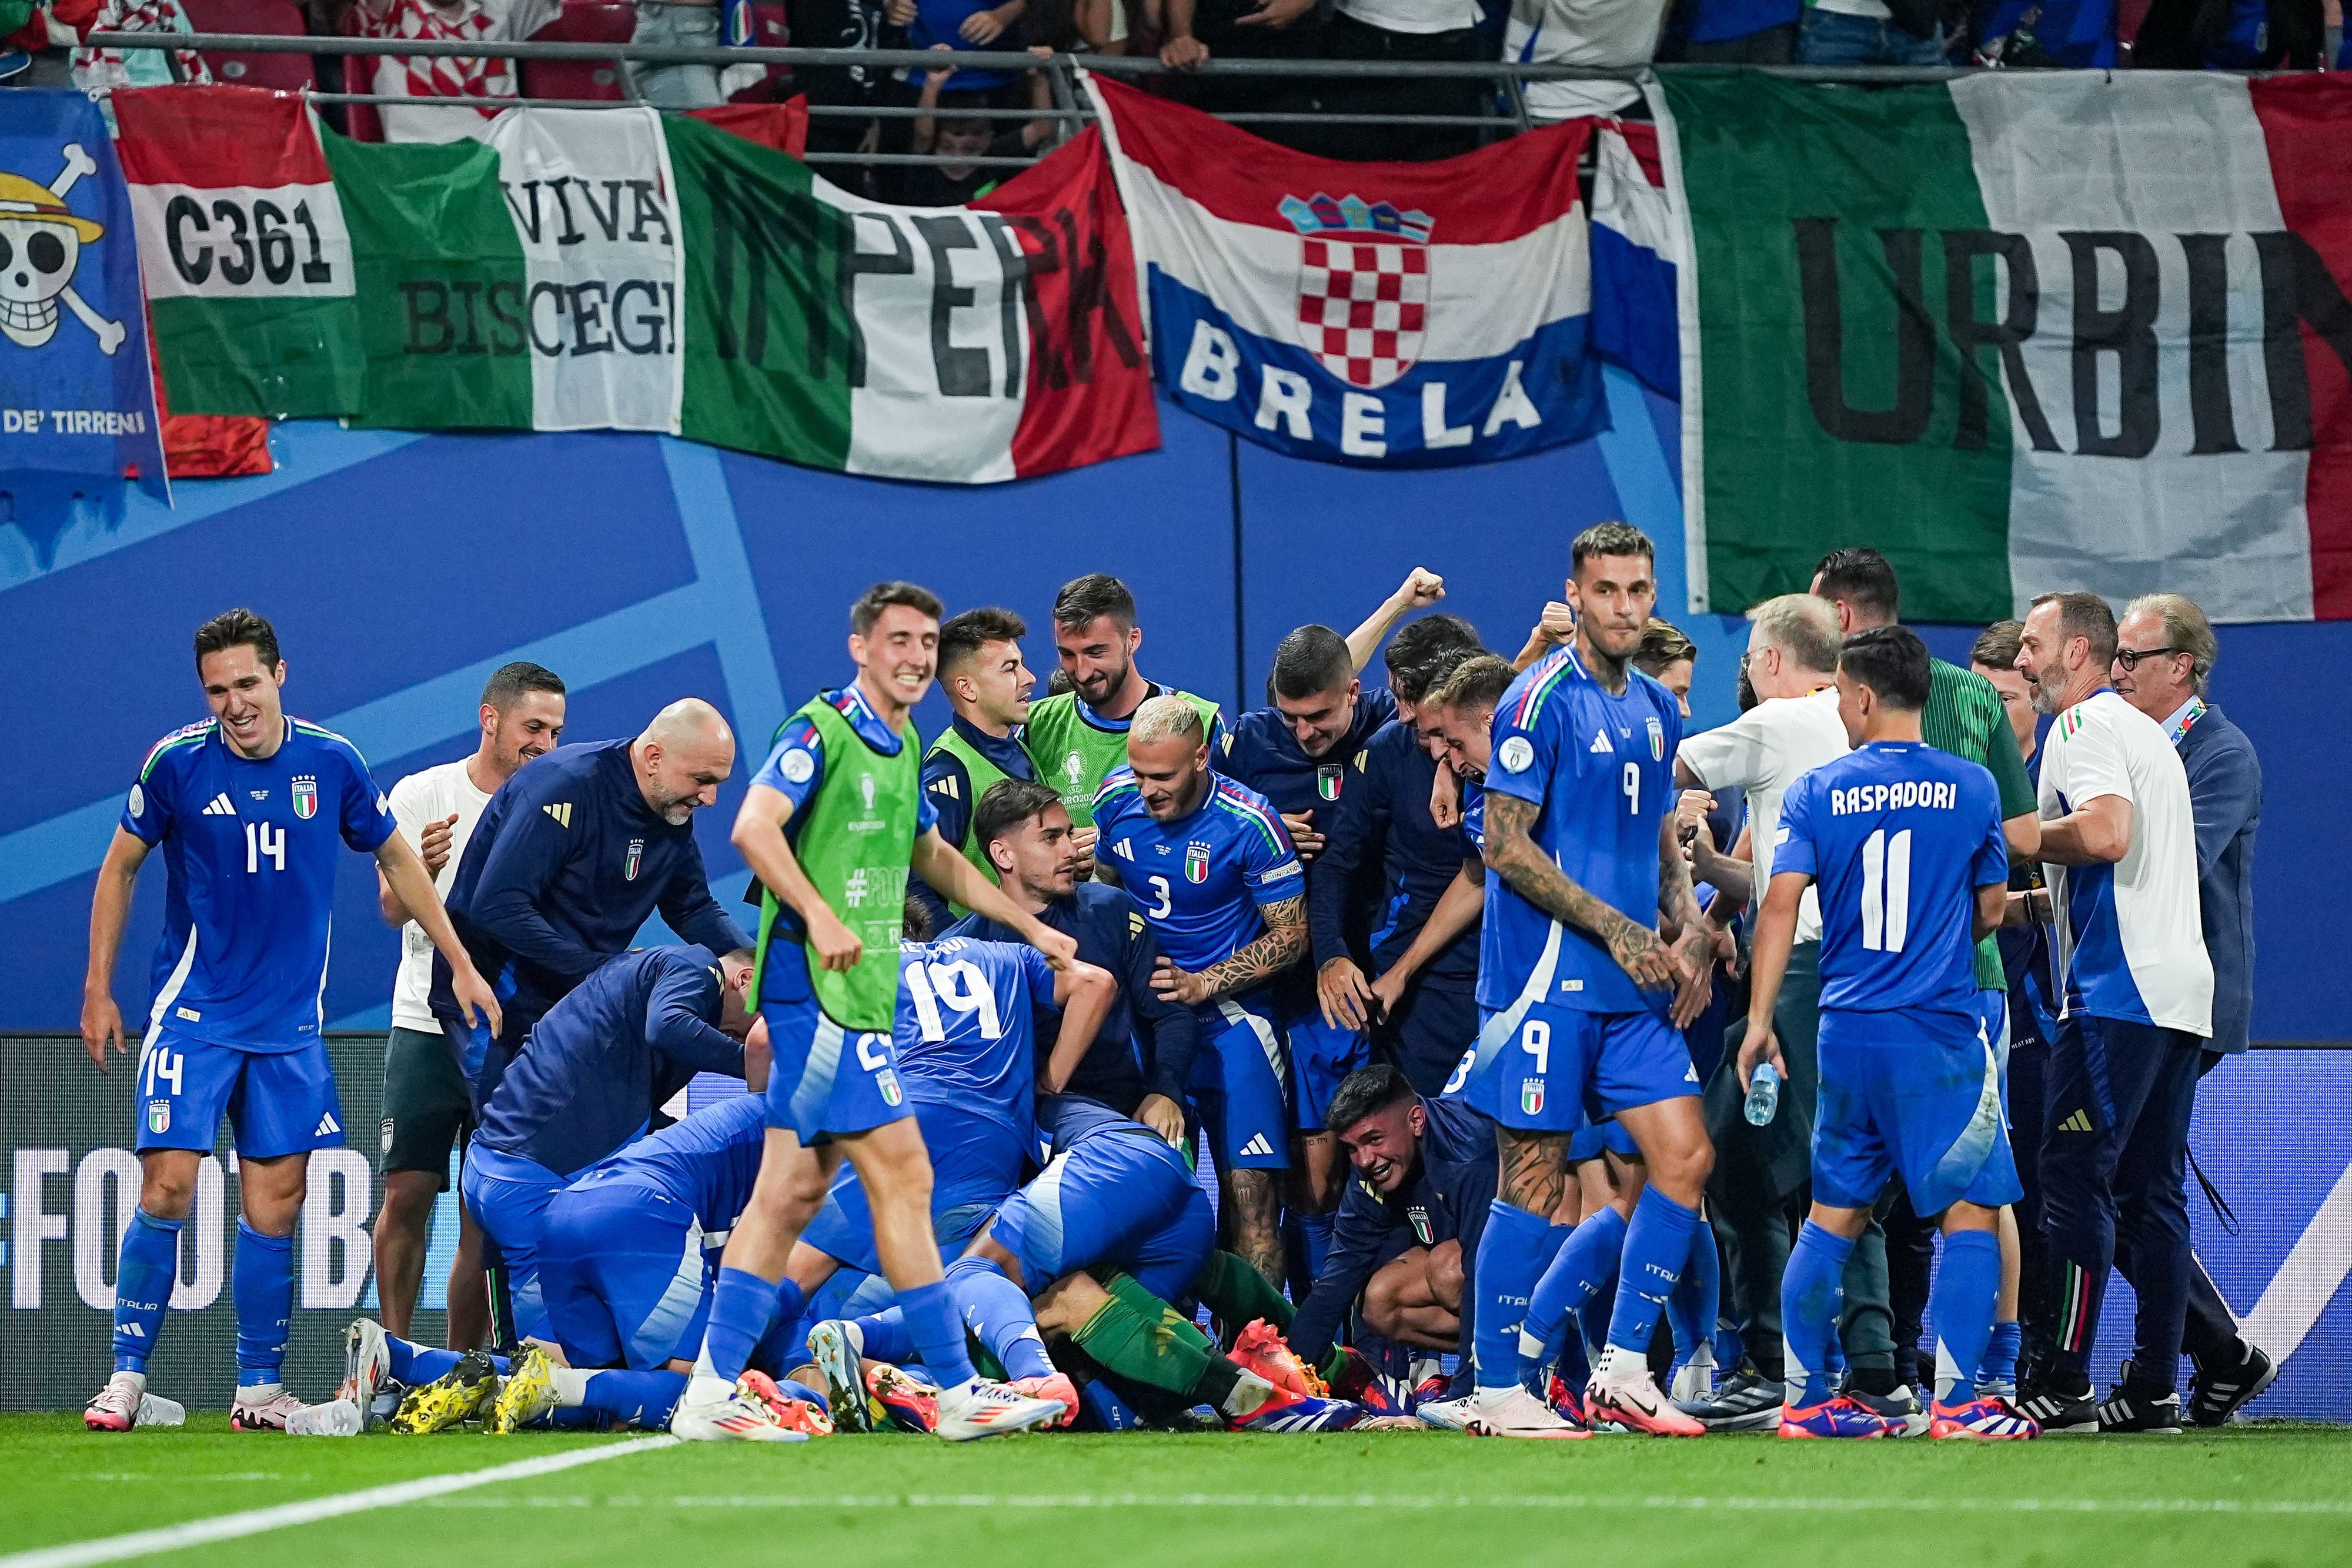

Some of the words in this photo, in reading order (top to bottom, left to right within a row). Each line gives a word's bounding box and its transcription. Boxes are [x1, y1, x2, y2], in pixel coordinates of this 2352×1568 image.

[500, 176, 673, 244] VIVA
[165, 195, 332, 285] C361
[1180, 319, 1542, 458] BRELA
[3, 409, 44, 433] DE'
[52, 409, 146, 436] TIRRENI
[294, 784, 315, 793] ITALIA
[1623, 761, 1640, 815] 9
[1831, 781, 1957, 816] RASPADORI
[246, 821, 285, 873] 14
[1189, 849, 1208, 859] ITALIA
[1148, 875, 1171, 920] 3
[1861, 829, 1911, 953] 11
[904, 959, 1001, 1042] 19
[146, 1047, 183, 1096] 14
[1522, 1020, 1551, 1074] 9
[118, 1298, 158, 1311] ITALIA
